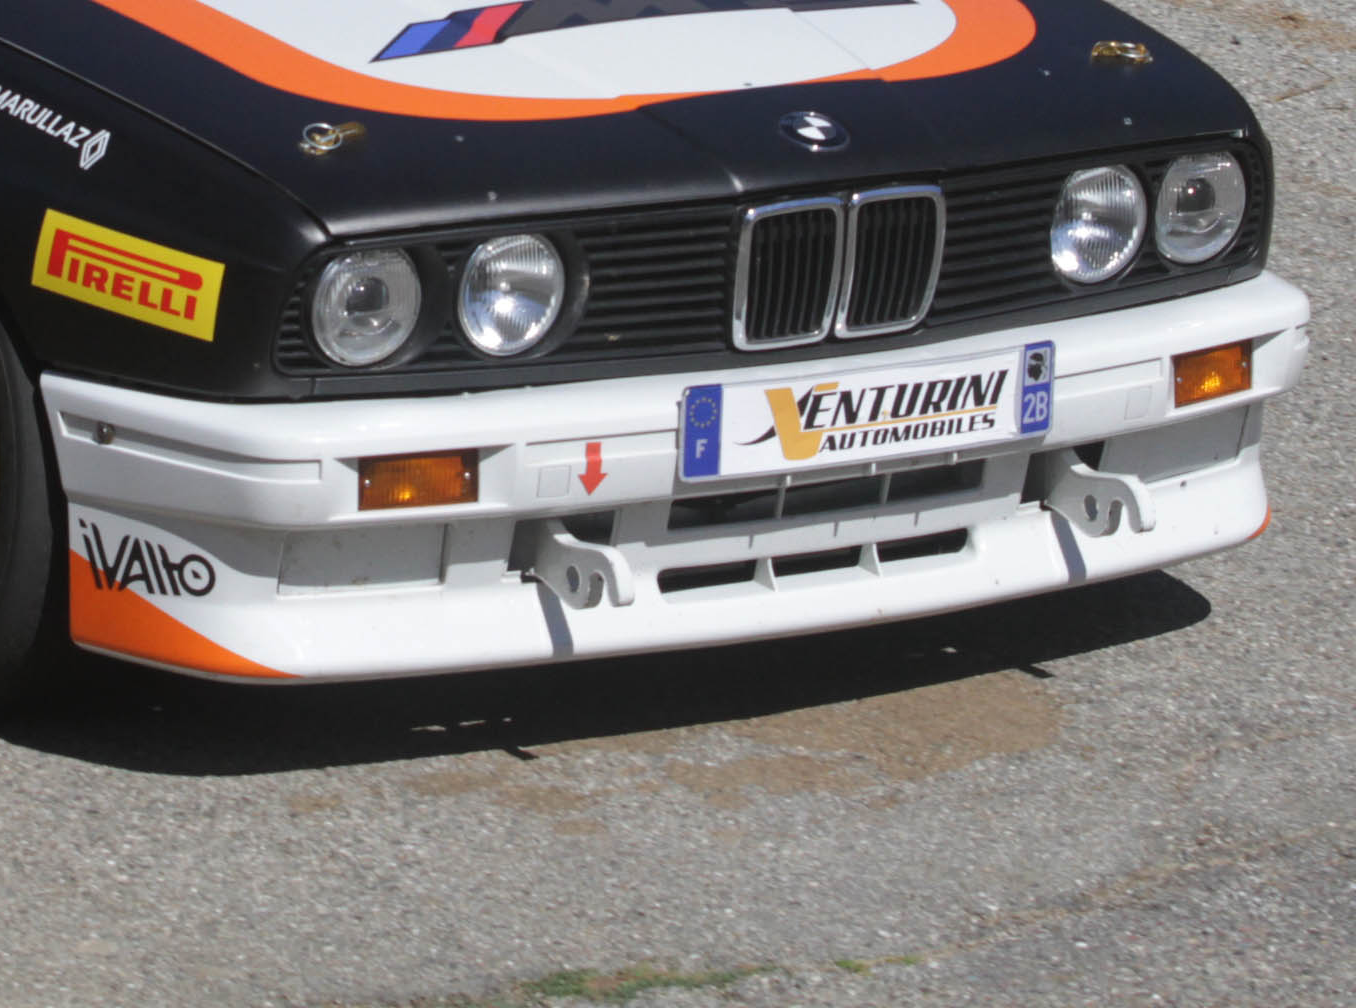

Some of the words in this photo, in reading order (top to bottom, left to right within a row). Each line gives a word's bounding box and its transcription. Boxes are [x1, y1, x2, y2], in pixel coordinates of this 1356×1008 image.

[46, 228, 203, 320] PIRELLI
[763, 368, 1010, 462] VENTURINI
[1022, 391, 1048, 424] 2B
[694, 438, 707, 460] F
[818, 412, 996, 453] AUTOMOBILES
